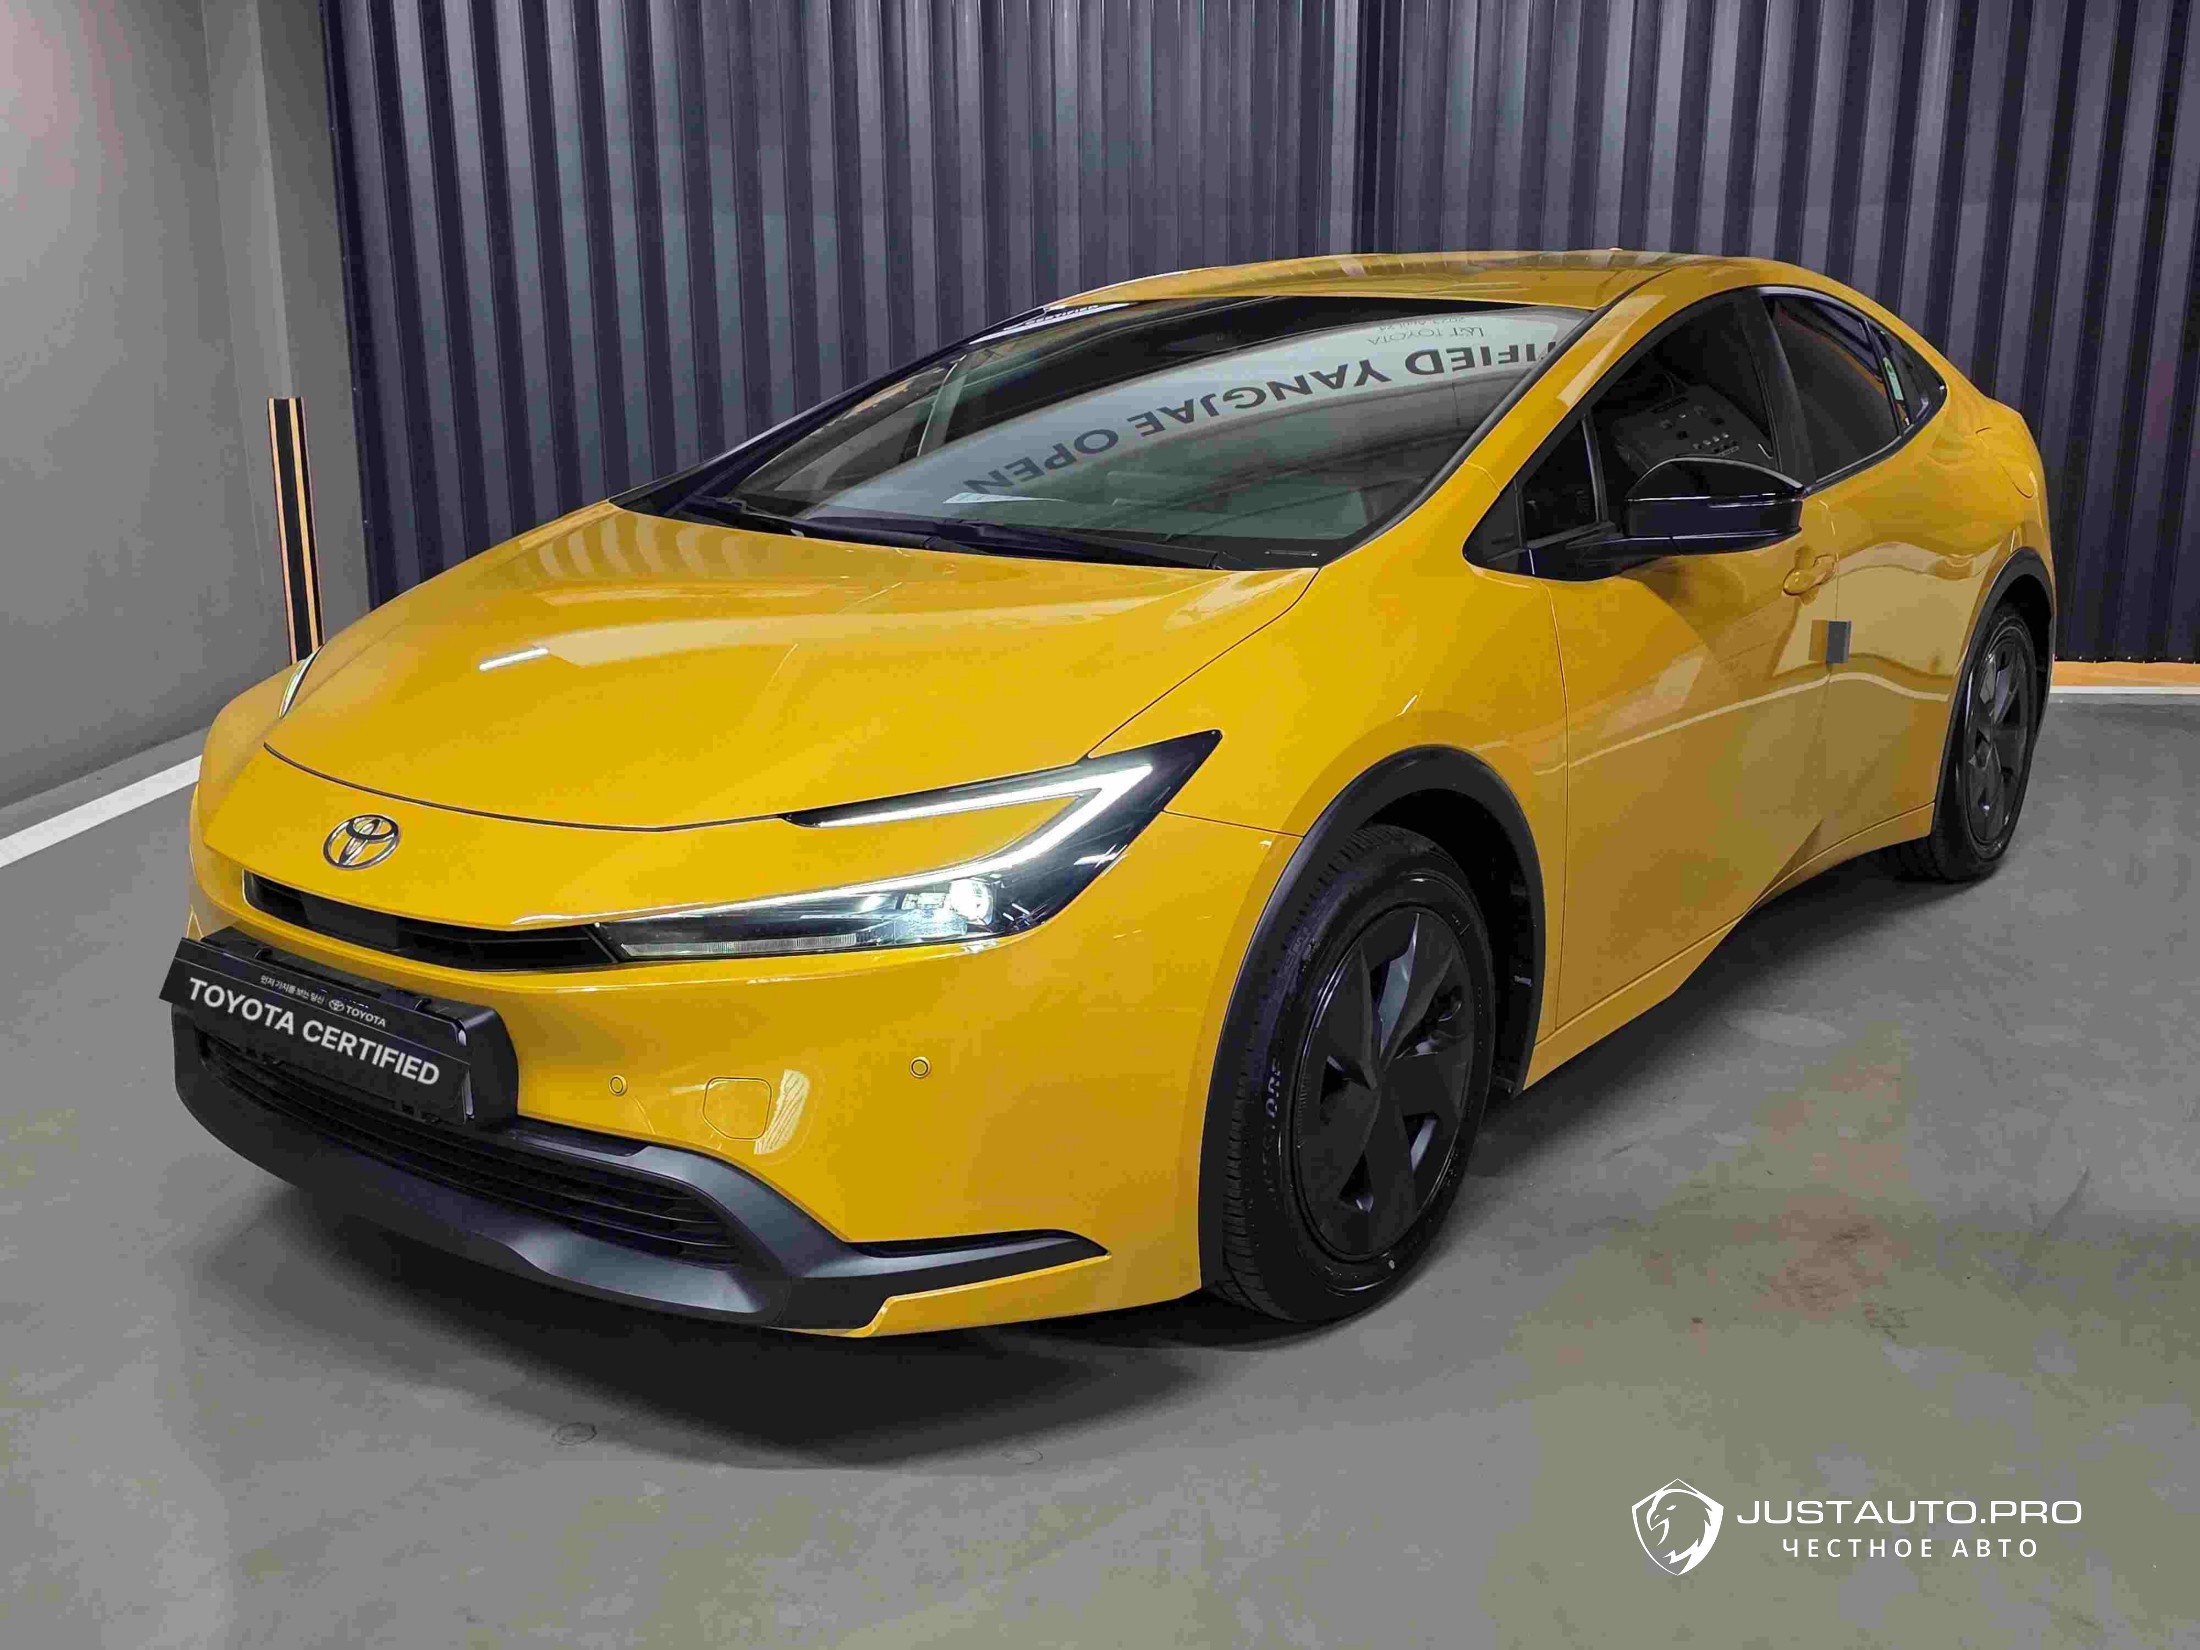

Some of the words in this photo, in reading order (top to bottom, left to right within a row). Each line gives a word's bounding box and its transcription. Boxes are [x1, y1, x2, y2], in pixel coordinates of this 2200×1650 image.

[1367, 327, 1442, 346] TOYOTA
[1128, 362, 1393, 440] YANGJAE
[963, 428, 1120, 496] OPEN
[189, 976, 295, 1036] TOYOTA
[302, 1020, 440, 1085] CERTIFIED
[345, 1005, 387, 1028] TOYOTA
